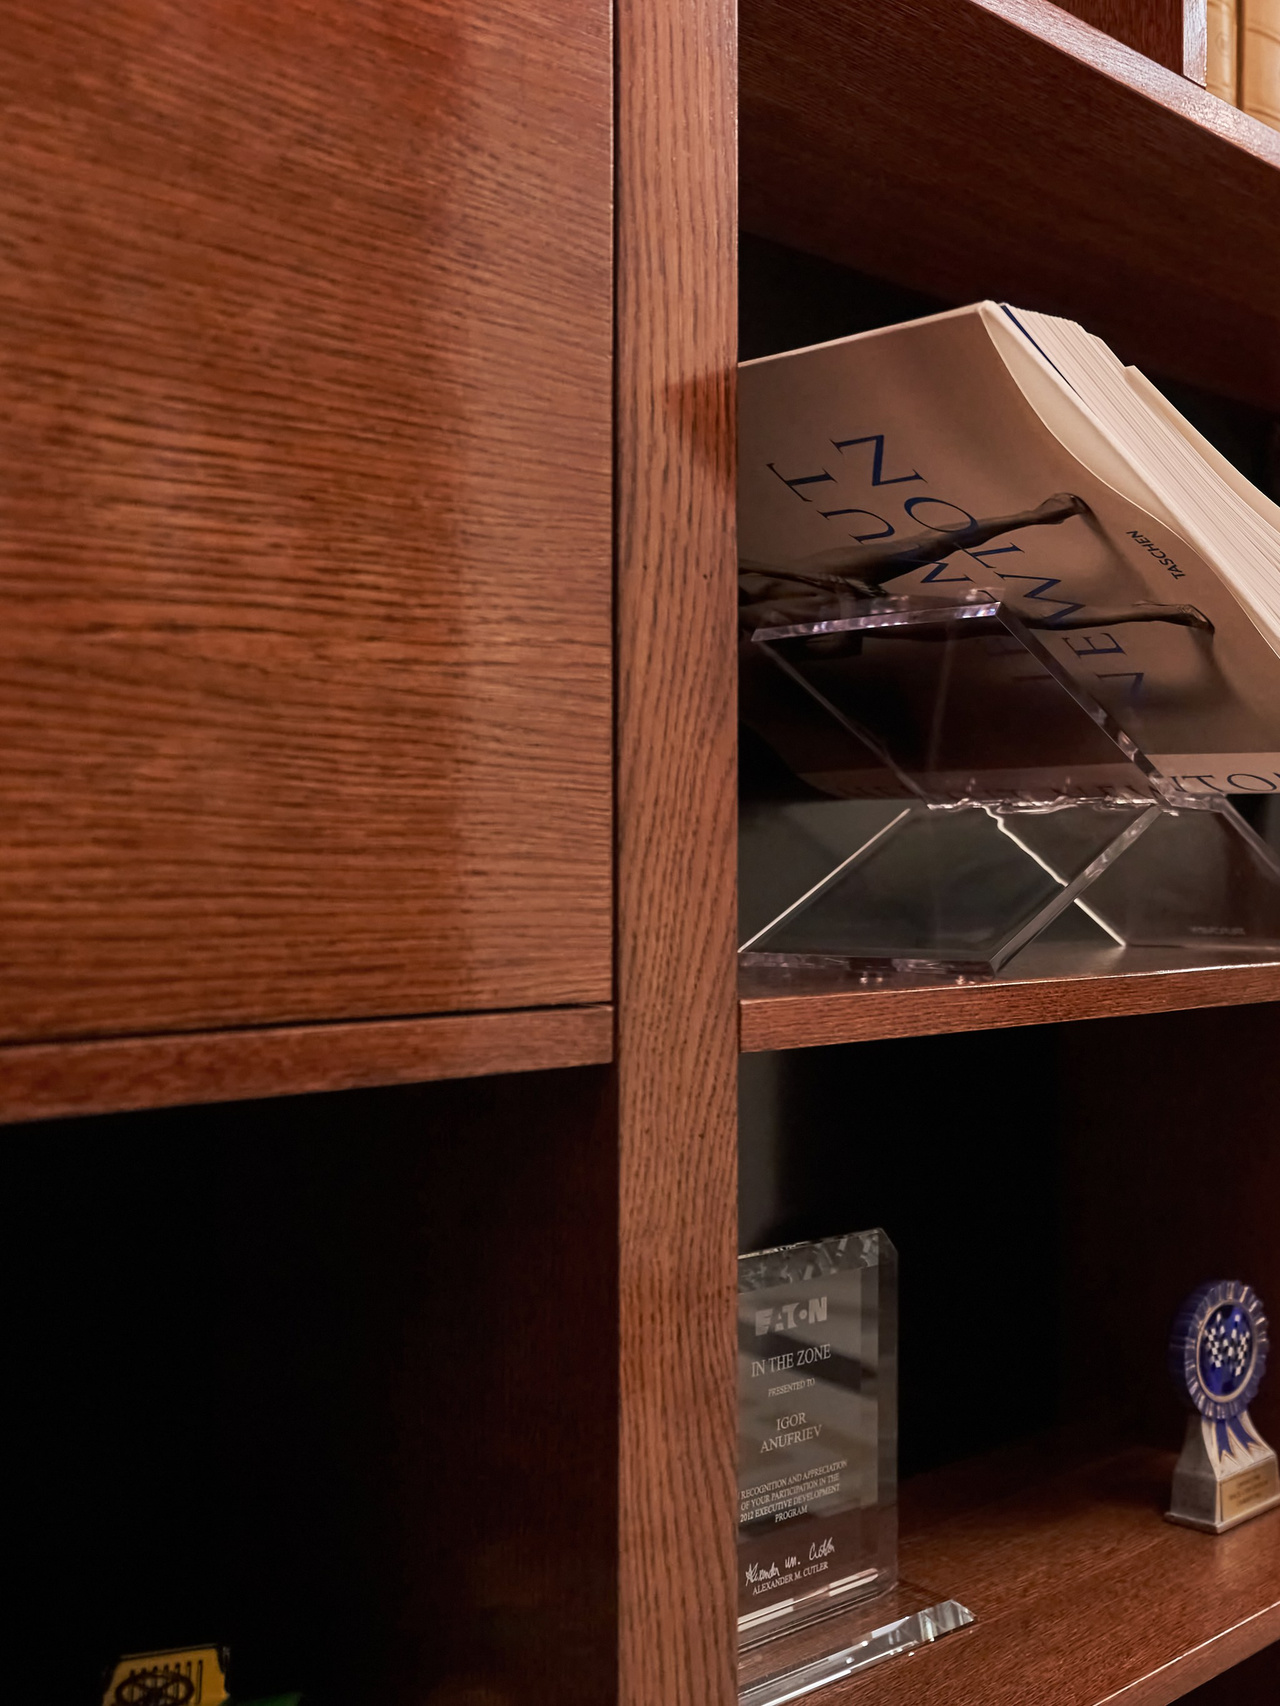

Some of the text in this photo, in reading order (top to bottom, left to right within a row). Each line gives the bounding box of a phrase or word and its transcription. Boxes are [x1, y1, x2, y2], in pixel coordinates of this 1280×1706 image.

[1126, 530, 1186, 580] TASCHEN
[755, 1296, 827, 1336] EATON
[751, 1343, 832, 1378] IN THE ZONE
[767, 1378, 816, 1397] PRESENTED TO
[760, 1424, 823, 1453] ANUFRIEV
[776, 1412, 807, 1431] IGOR
[740, 1472, 840, 1511] OF YOUR PARTICIPATION IN THE
[741, 1460, 848, 1499] RECOGNITION AND APPRECIATION
[740, 1483, 840, 1523] 2012 EXECUTIVE DEVELOPMENT
[775, 1505, 808, 1523] PROGRAM
[752, 1561, 829, 1596] ALEXANDER M. CUTLER
